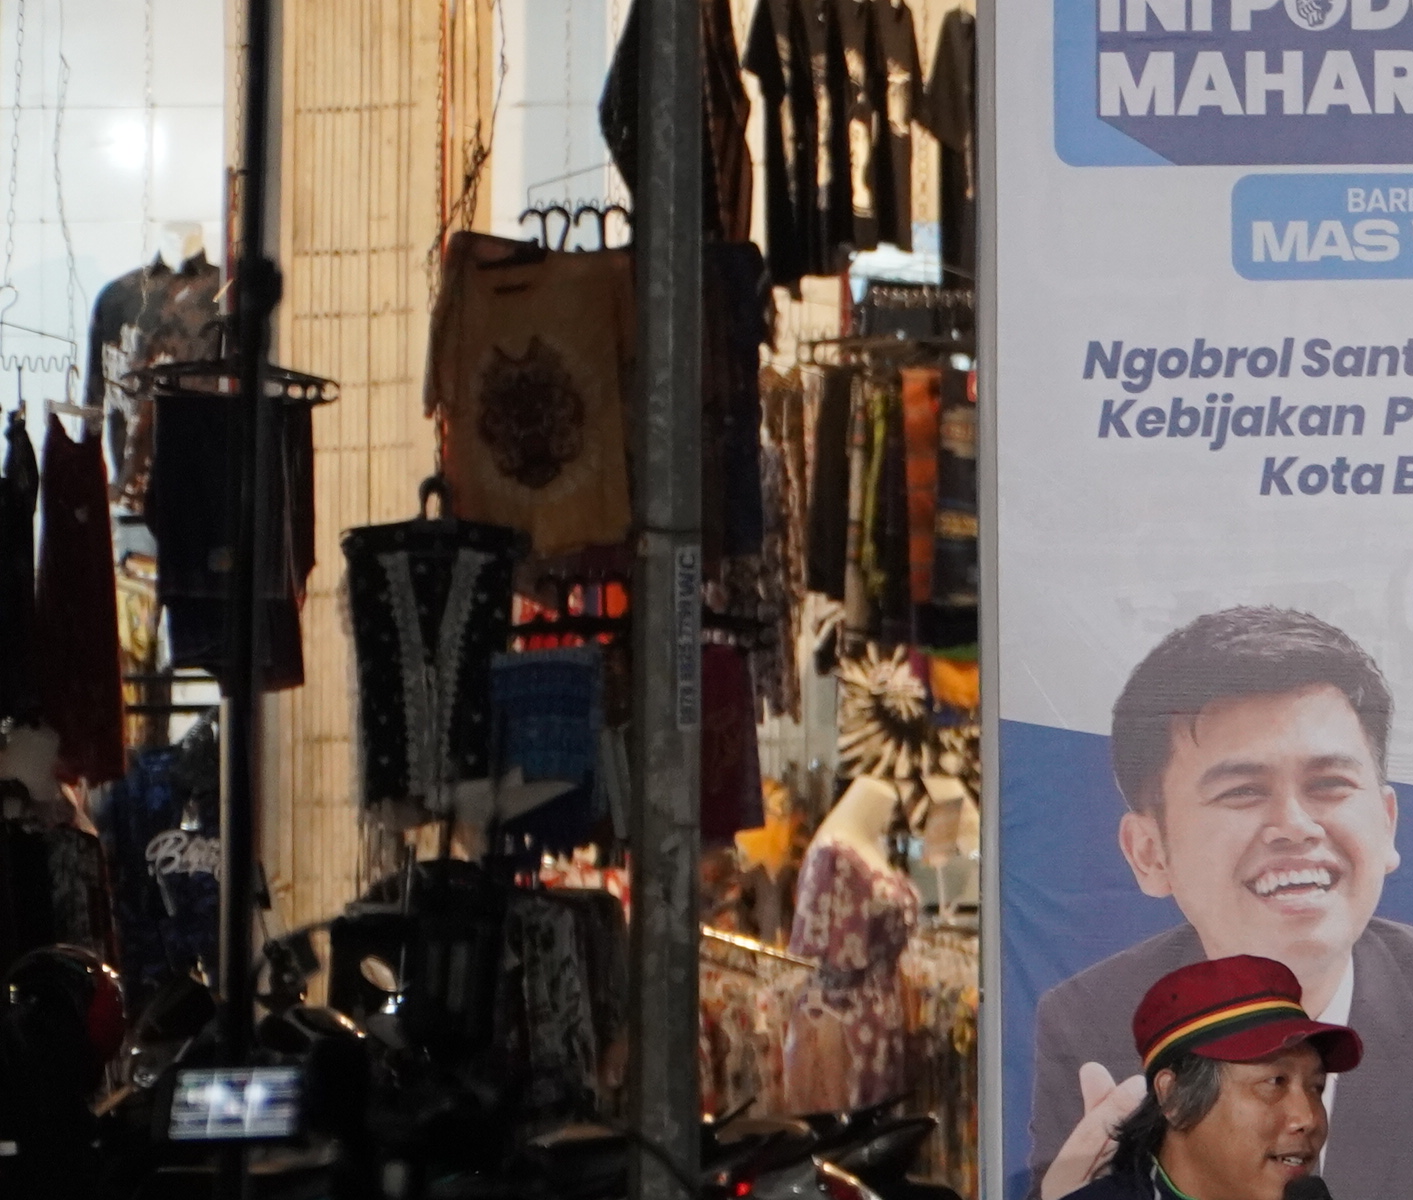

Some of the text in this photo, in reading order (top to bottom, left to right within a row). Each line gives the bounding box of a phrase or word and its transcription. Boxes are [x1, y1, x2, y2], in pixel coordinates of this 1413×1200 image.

[1252, 219, 1399, 262] MAS
[1083, 338, 1294, 393] Ngobrol
[1098, 392, 1365, 451] Kebijakan
[1260, 457, 1384, 495] Kota
